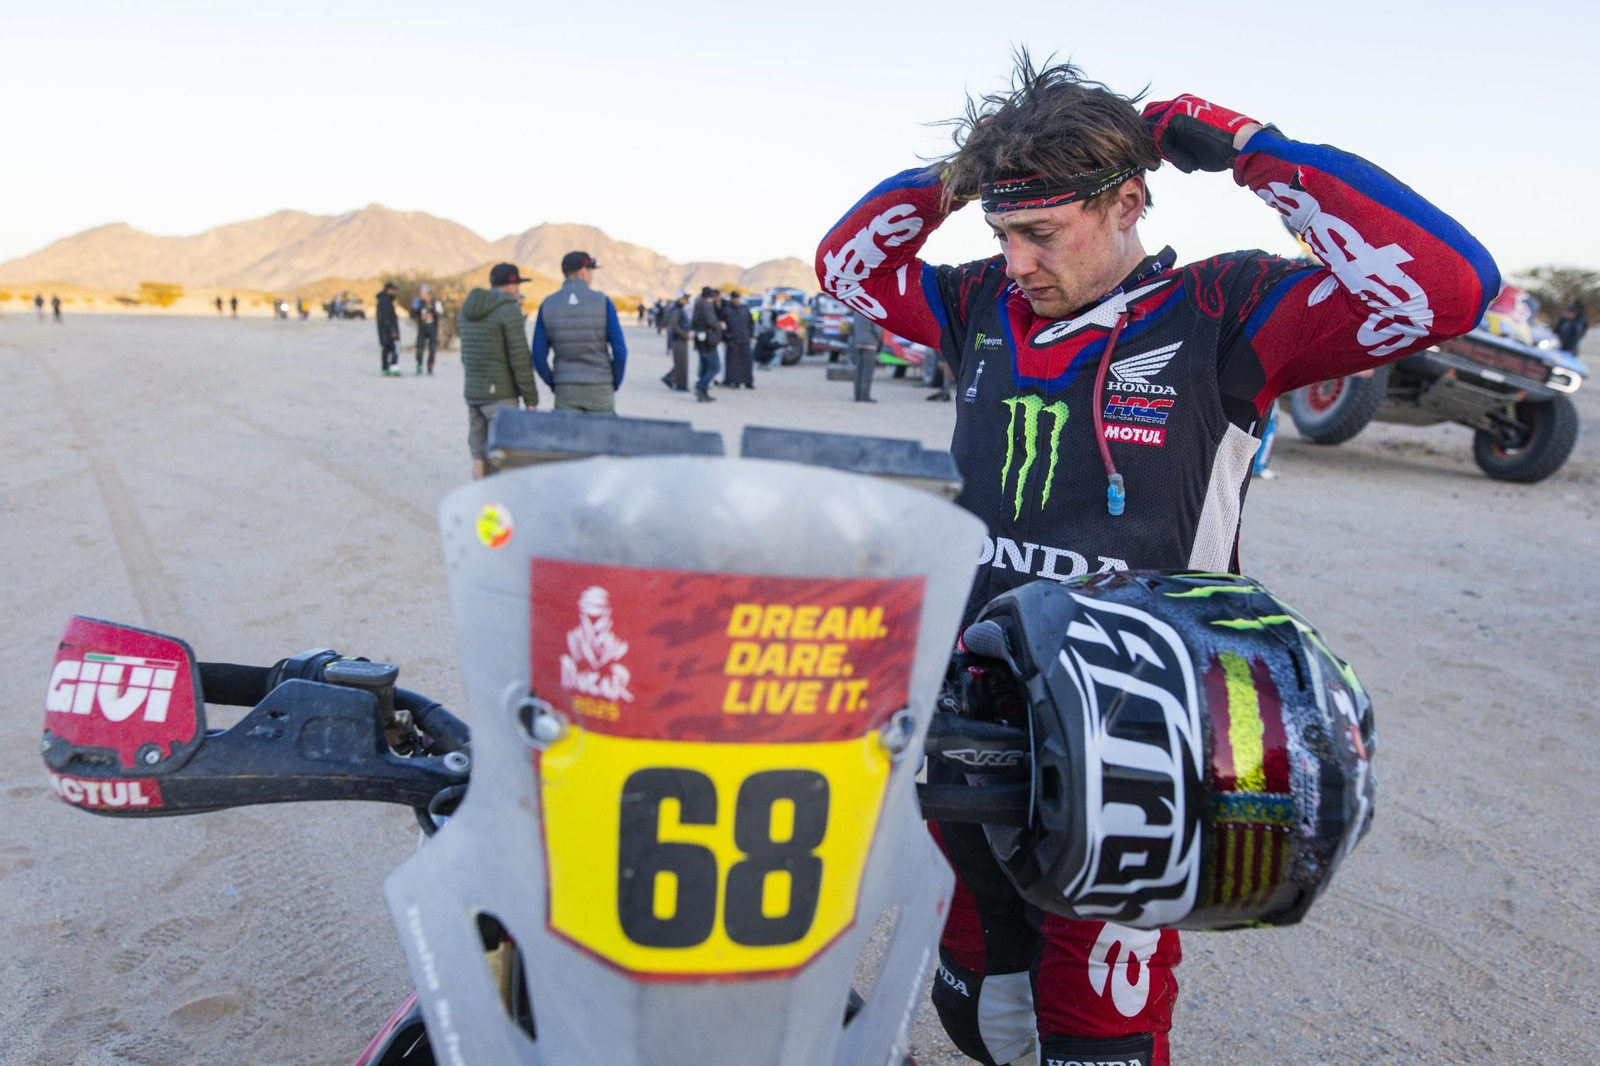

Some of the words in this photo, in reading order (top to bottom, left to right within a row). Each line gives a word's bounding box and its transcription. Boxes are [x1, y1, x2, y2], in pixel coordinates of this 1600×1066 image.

[1106, 381, 1178, 396] HONDA
[1104, 394, 1175, 421] HRC
[1104, 425, 1163, 444] MOTUL
[726, 603, 889, 641] DREAM.
[724, 641, 854, 678] DARE.
[46, 659, 177, 723] GIVI
[722, 679, 824, 715] LIVE
[826, 679, 870, 715] IT.
[616, 766, 832, 950] 68
